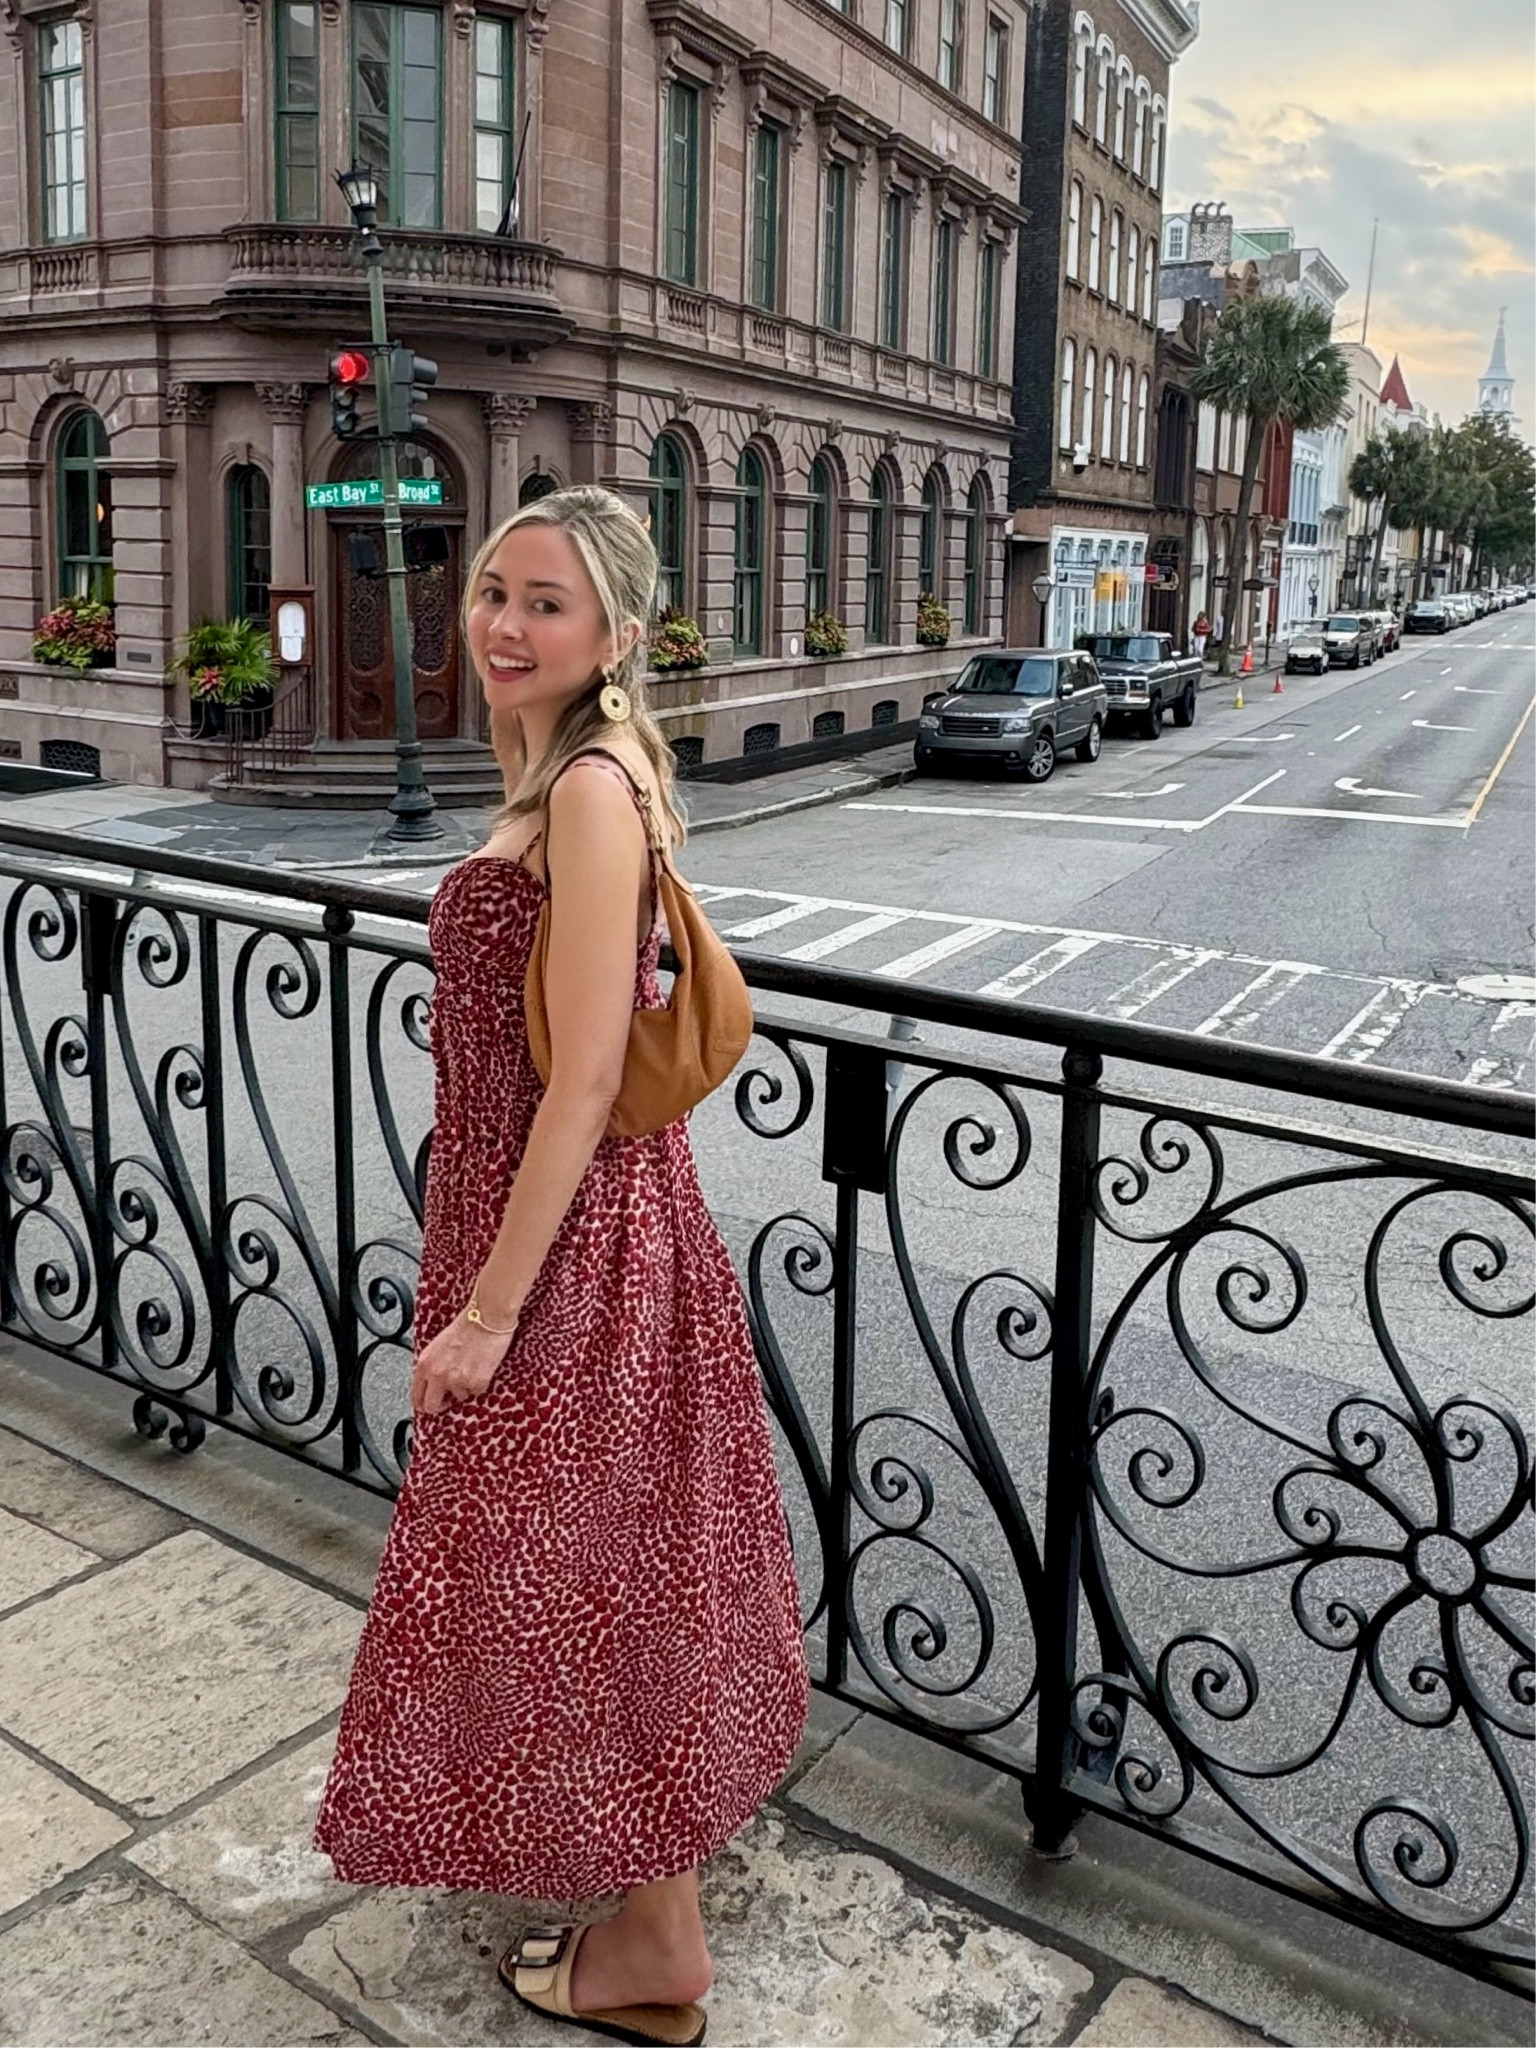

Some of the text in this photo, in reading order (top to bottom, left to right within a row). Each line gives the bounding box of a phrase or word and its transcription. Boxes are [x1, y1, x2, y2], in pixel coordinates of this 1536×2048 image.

[310, 487, 339, 504] East
[342, 485, 367, 502] Bay
[398, 483, 430, 500] Broad
